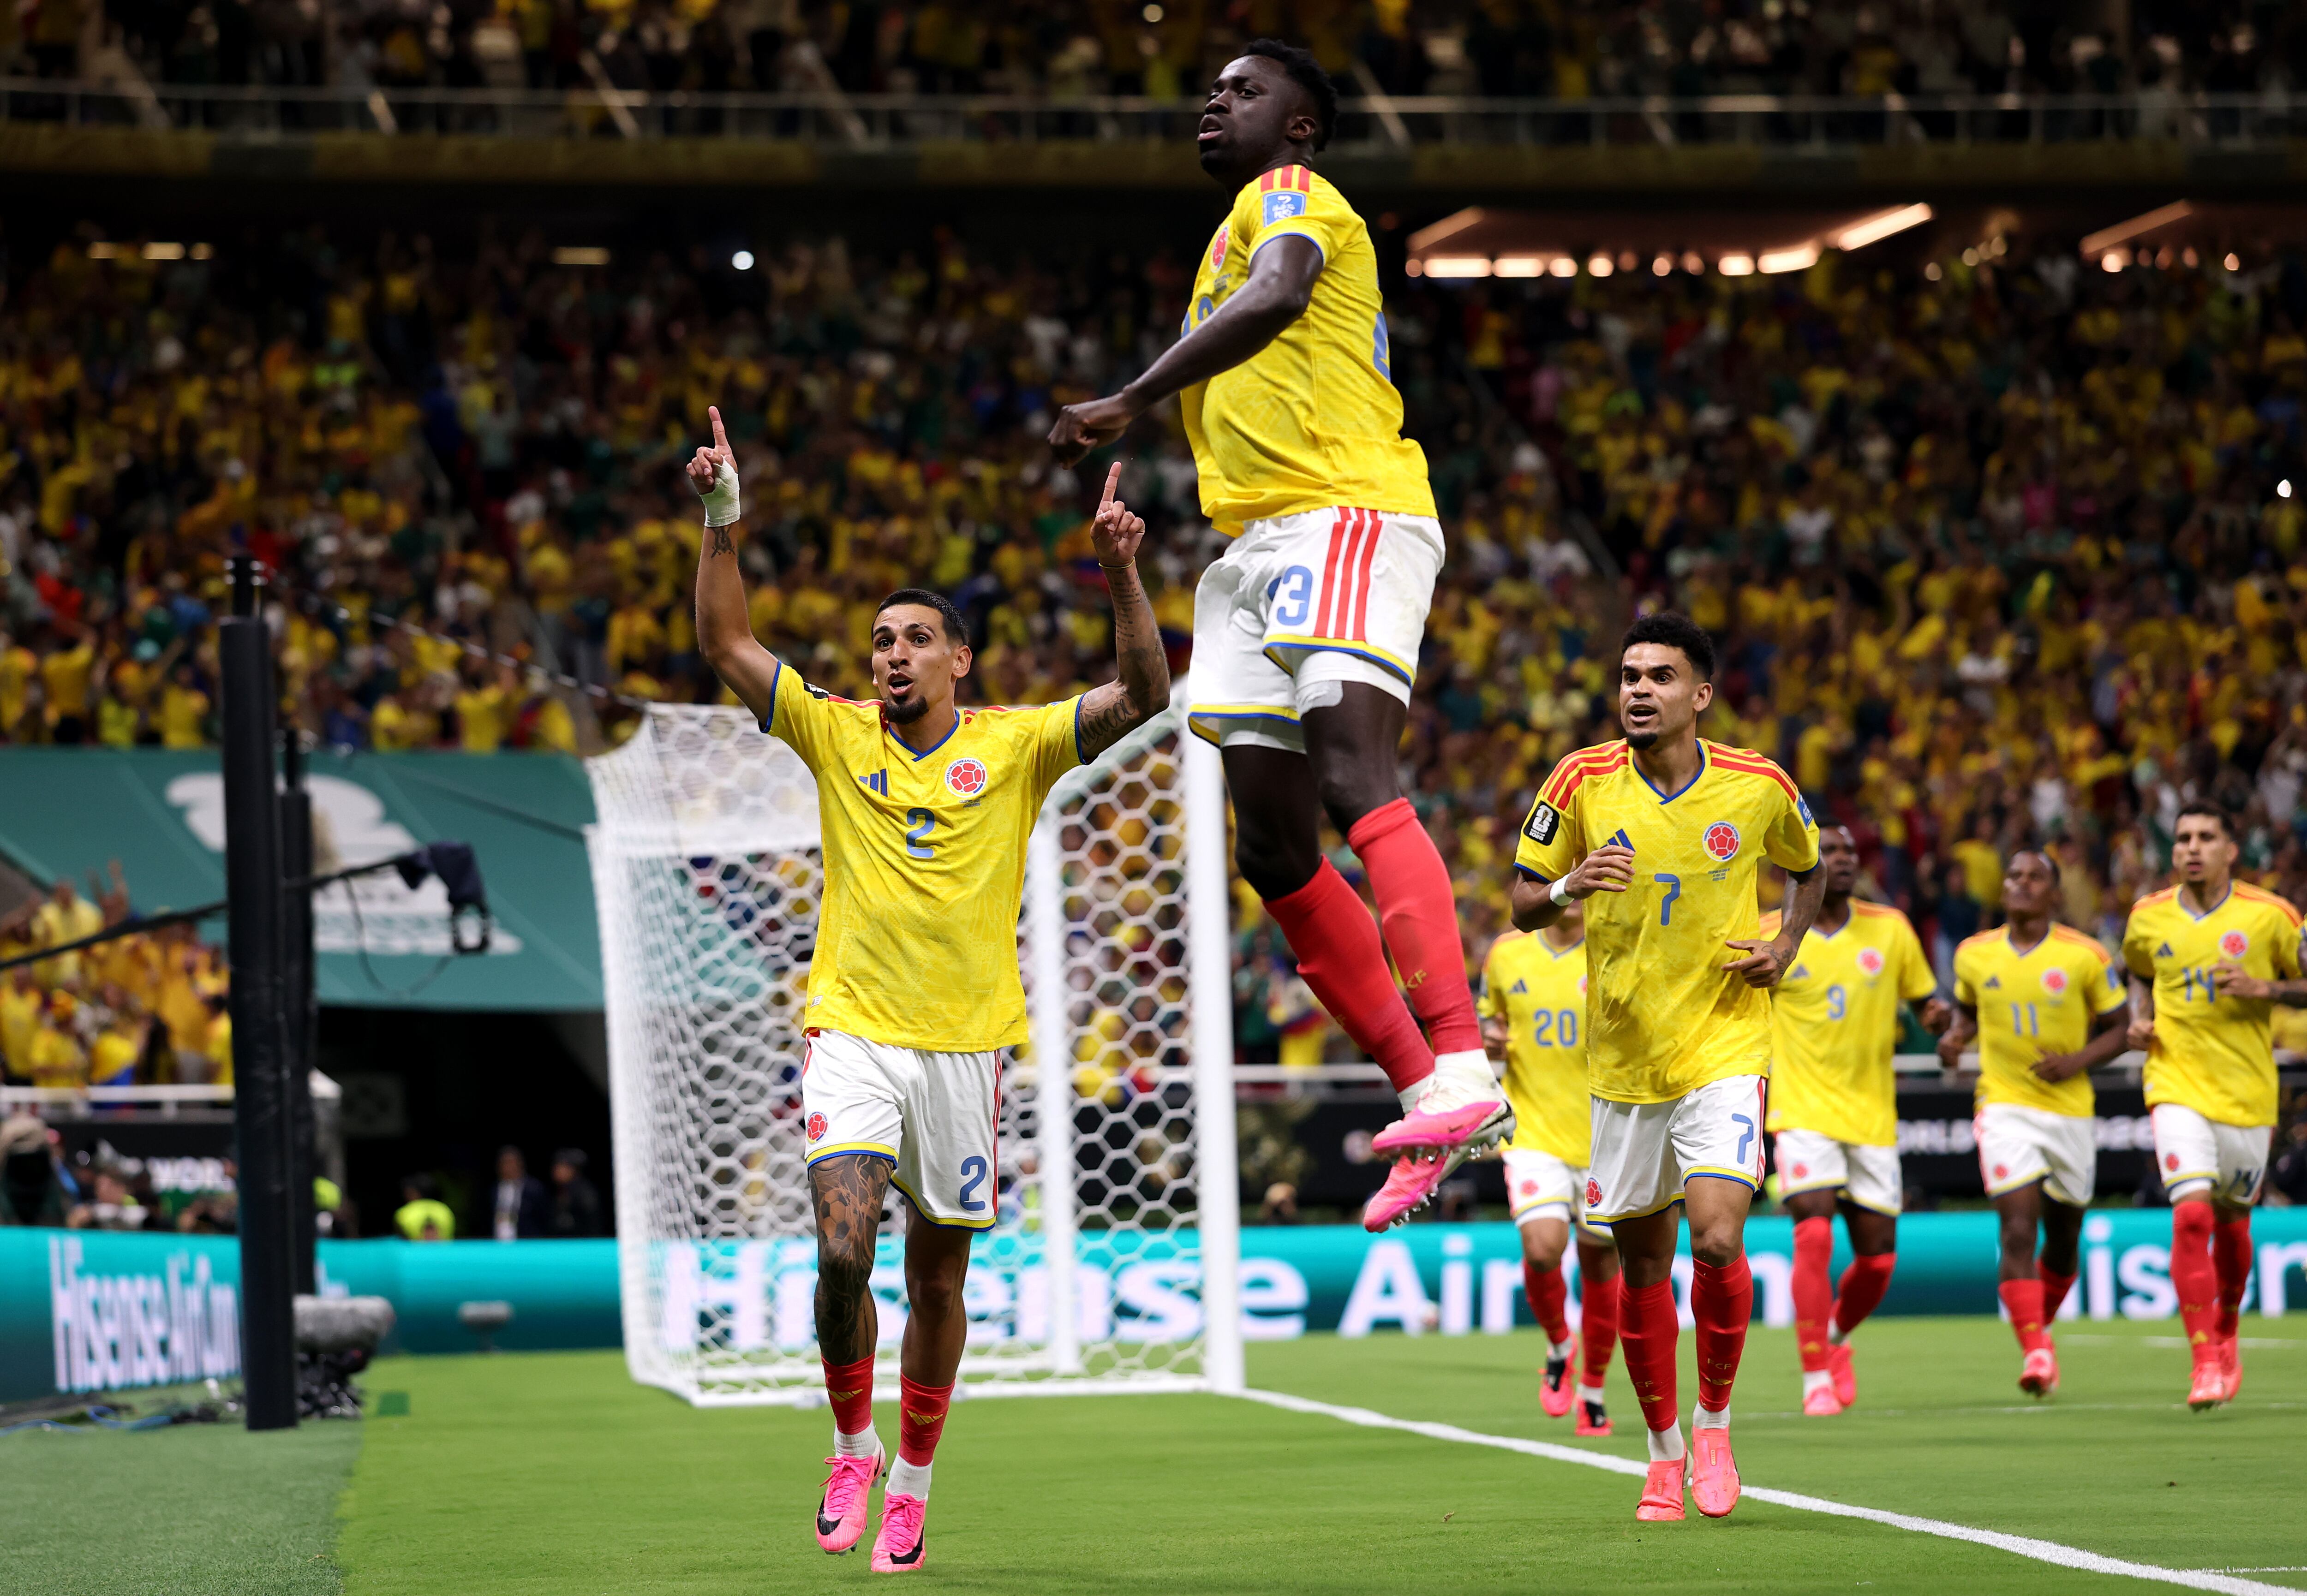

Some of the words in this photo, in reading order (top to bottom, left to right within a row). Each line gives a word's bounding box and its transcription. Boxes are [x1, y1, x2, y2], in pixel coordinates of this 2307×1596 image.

[1267, 565, 1313, 626] 3
[907, 808, 935, 858] 2
[1654, 873, 1680, 926] 7
[1827, 984, 1846, 1020] 9
[2182, 967, 2214, 1003] 14
[1534, 1009, 1577, 1047] 20
[2010, 1002, 2039, 1036] 11
[1732, 1113, 1753, 1164] 7
[959, 1156, 986, 1211] 2
[2229, 1167, 2262, 1198] 14
